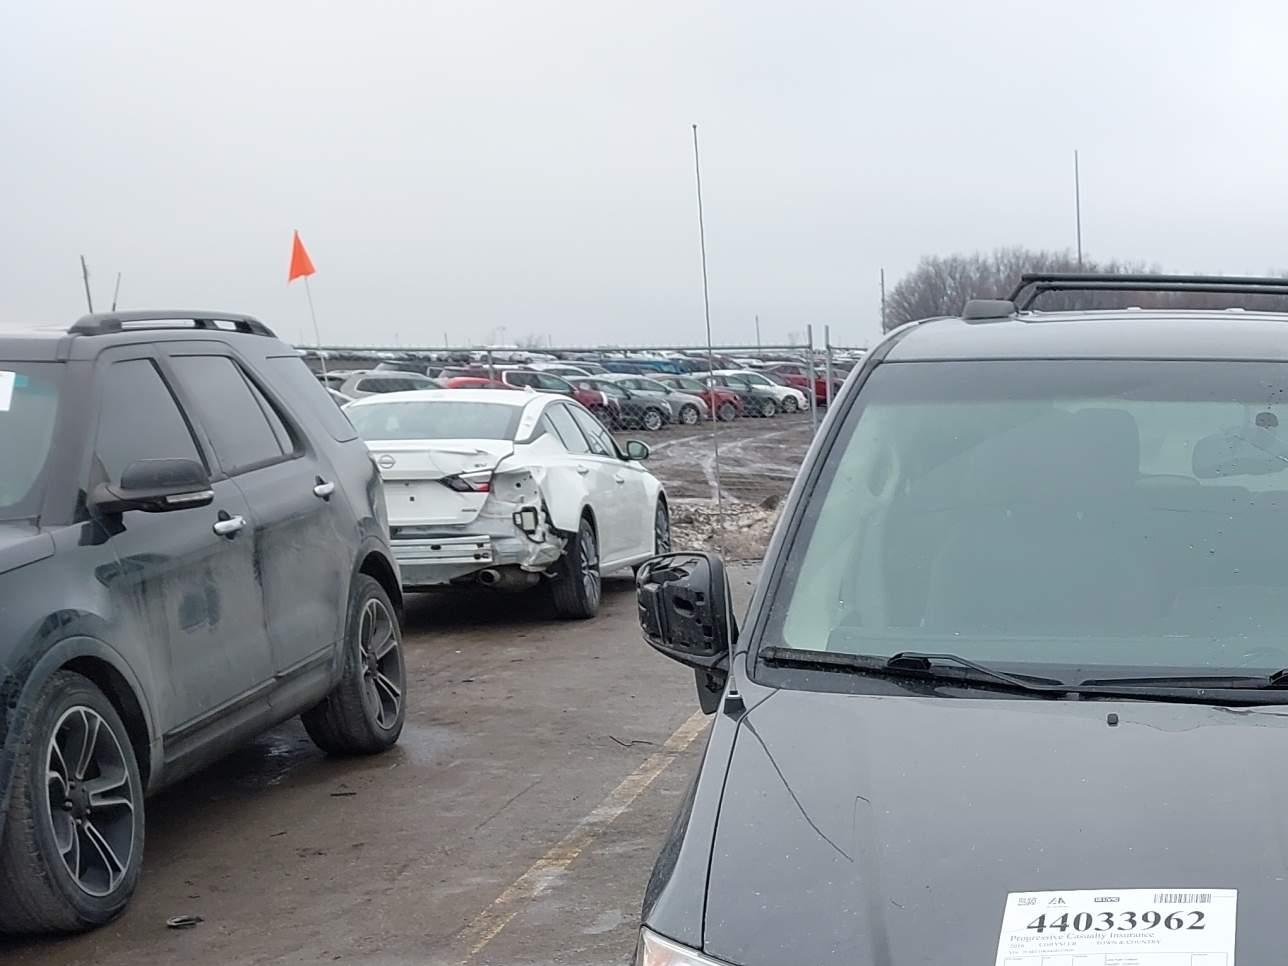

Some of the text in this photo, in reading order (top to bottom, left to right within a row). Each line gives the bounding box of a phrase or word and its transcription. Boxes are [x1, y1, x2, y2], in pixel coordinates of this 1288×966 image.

[1026, 911, 1206, 933] 44033962
[1010, 931, 1155, 943] Progressive Casualty Insurance
